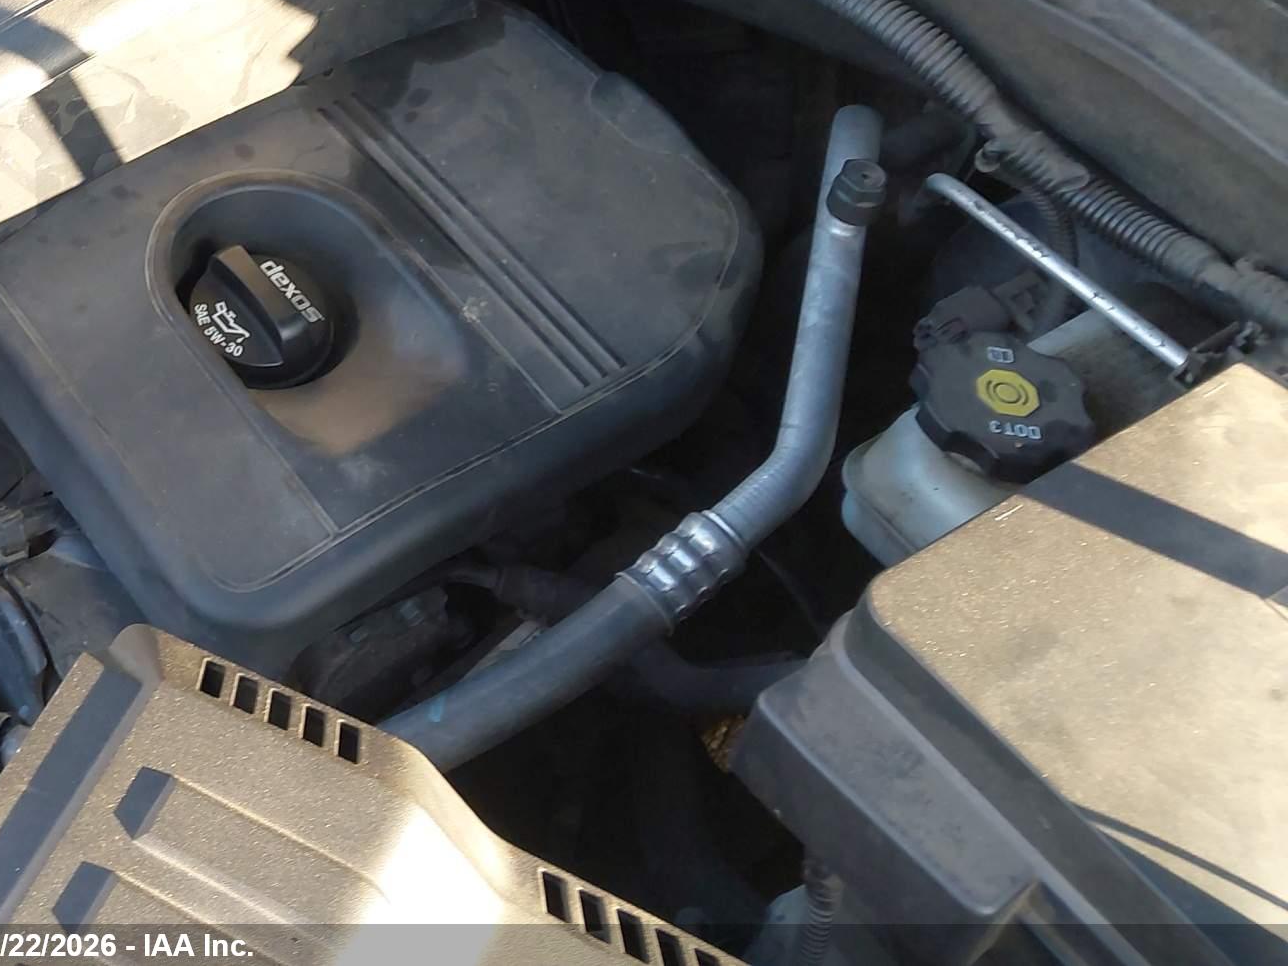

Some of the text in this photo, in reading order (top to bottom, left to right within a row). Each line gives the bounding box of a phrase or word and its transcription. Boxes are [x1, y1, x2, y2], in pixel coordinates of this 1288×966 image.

[260, 260, 322, 323] dexos
[193, 303, 243, 358] SAE 5W-30
